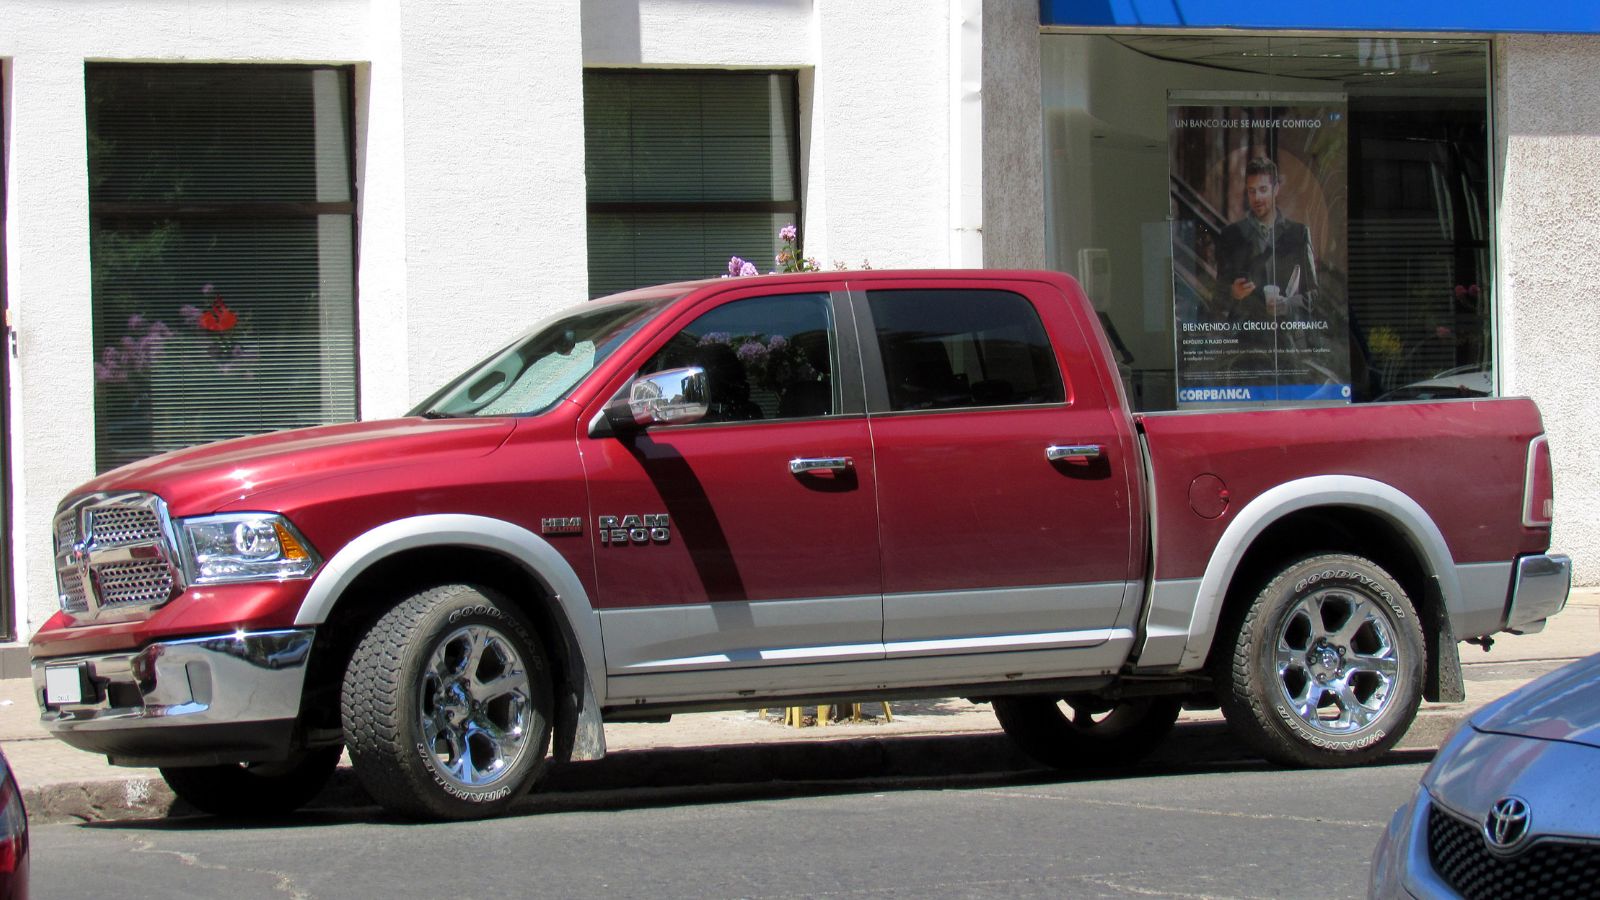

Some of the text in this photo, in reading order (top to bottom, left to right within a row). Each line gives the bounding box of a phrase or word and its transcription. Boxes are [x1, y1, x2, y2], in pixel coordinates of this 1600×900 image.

[1175, 119, 1322, 129] UN BANCO QUE SE MUEVE CONTIGO
[1182, 319, 1329, 332] BIENVENIDO AL CÍRCULO CORPBANCA
[1179, 388, 1251, 401] CORPBANCA
[541, 517, 582, 527] HEMI
[598, 513, 670, 528] RAM
[599, 527, 671, 542] 1500
[1295, 569, 1405, 619] GOODYEAR
[1276, 705, 1386, 750] WRANGLER
[416, 742, 511, 803] WRANGLER
